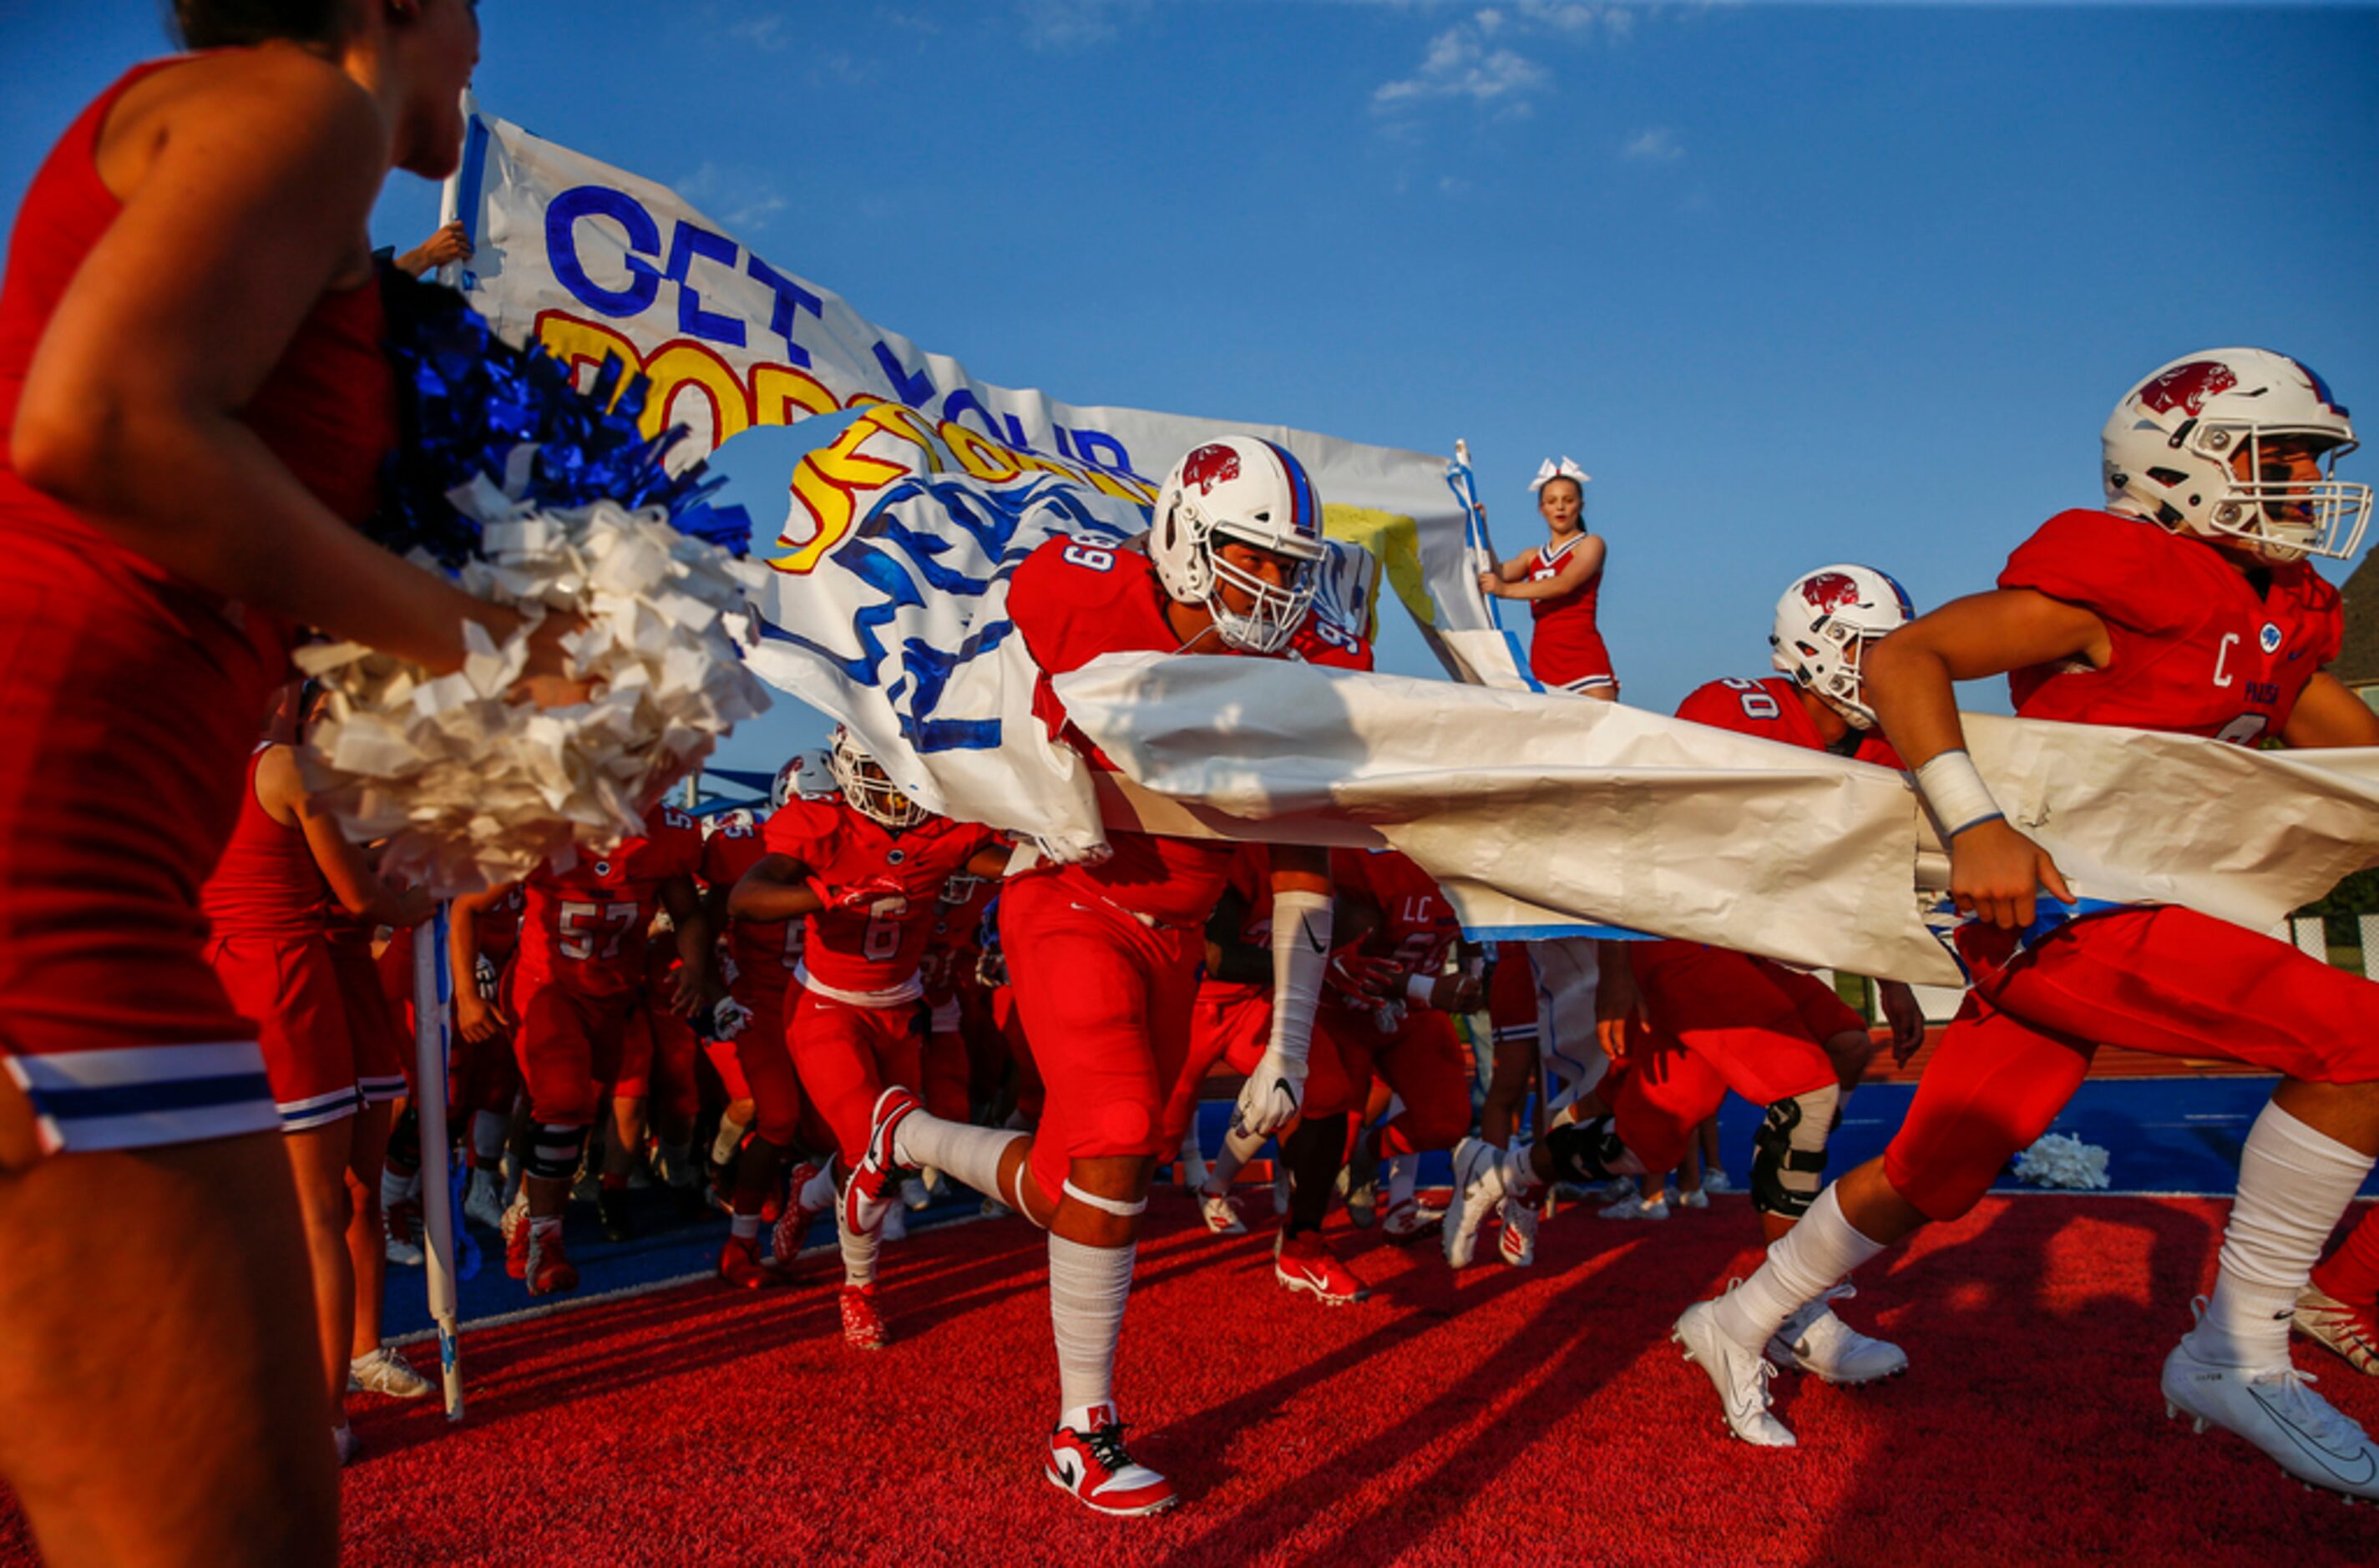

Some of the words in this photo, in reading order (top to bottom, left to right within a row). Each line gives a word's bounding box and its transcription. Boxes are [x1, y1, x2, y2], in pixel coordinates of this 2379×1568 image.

[545, 185, 823, 369] GET
[2213, 631, 2240, 688] C
[559, 900, 640, 961] 57
[863, 896, 909, 961] 6
[1403, 896, 1433, 923] LC
